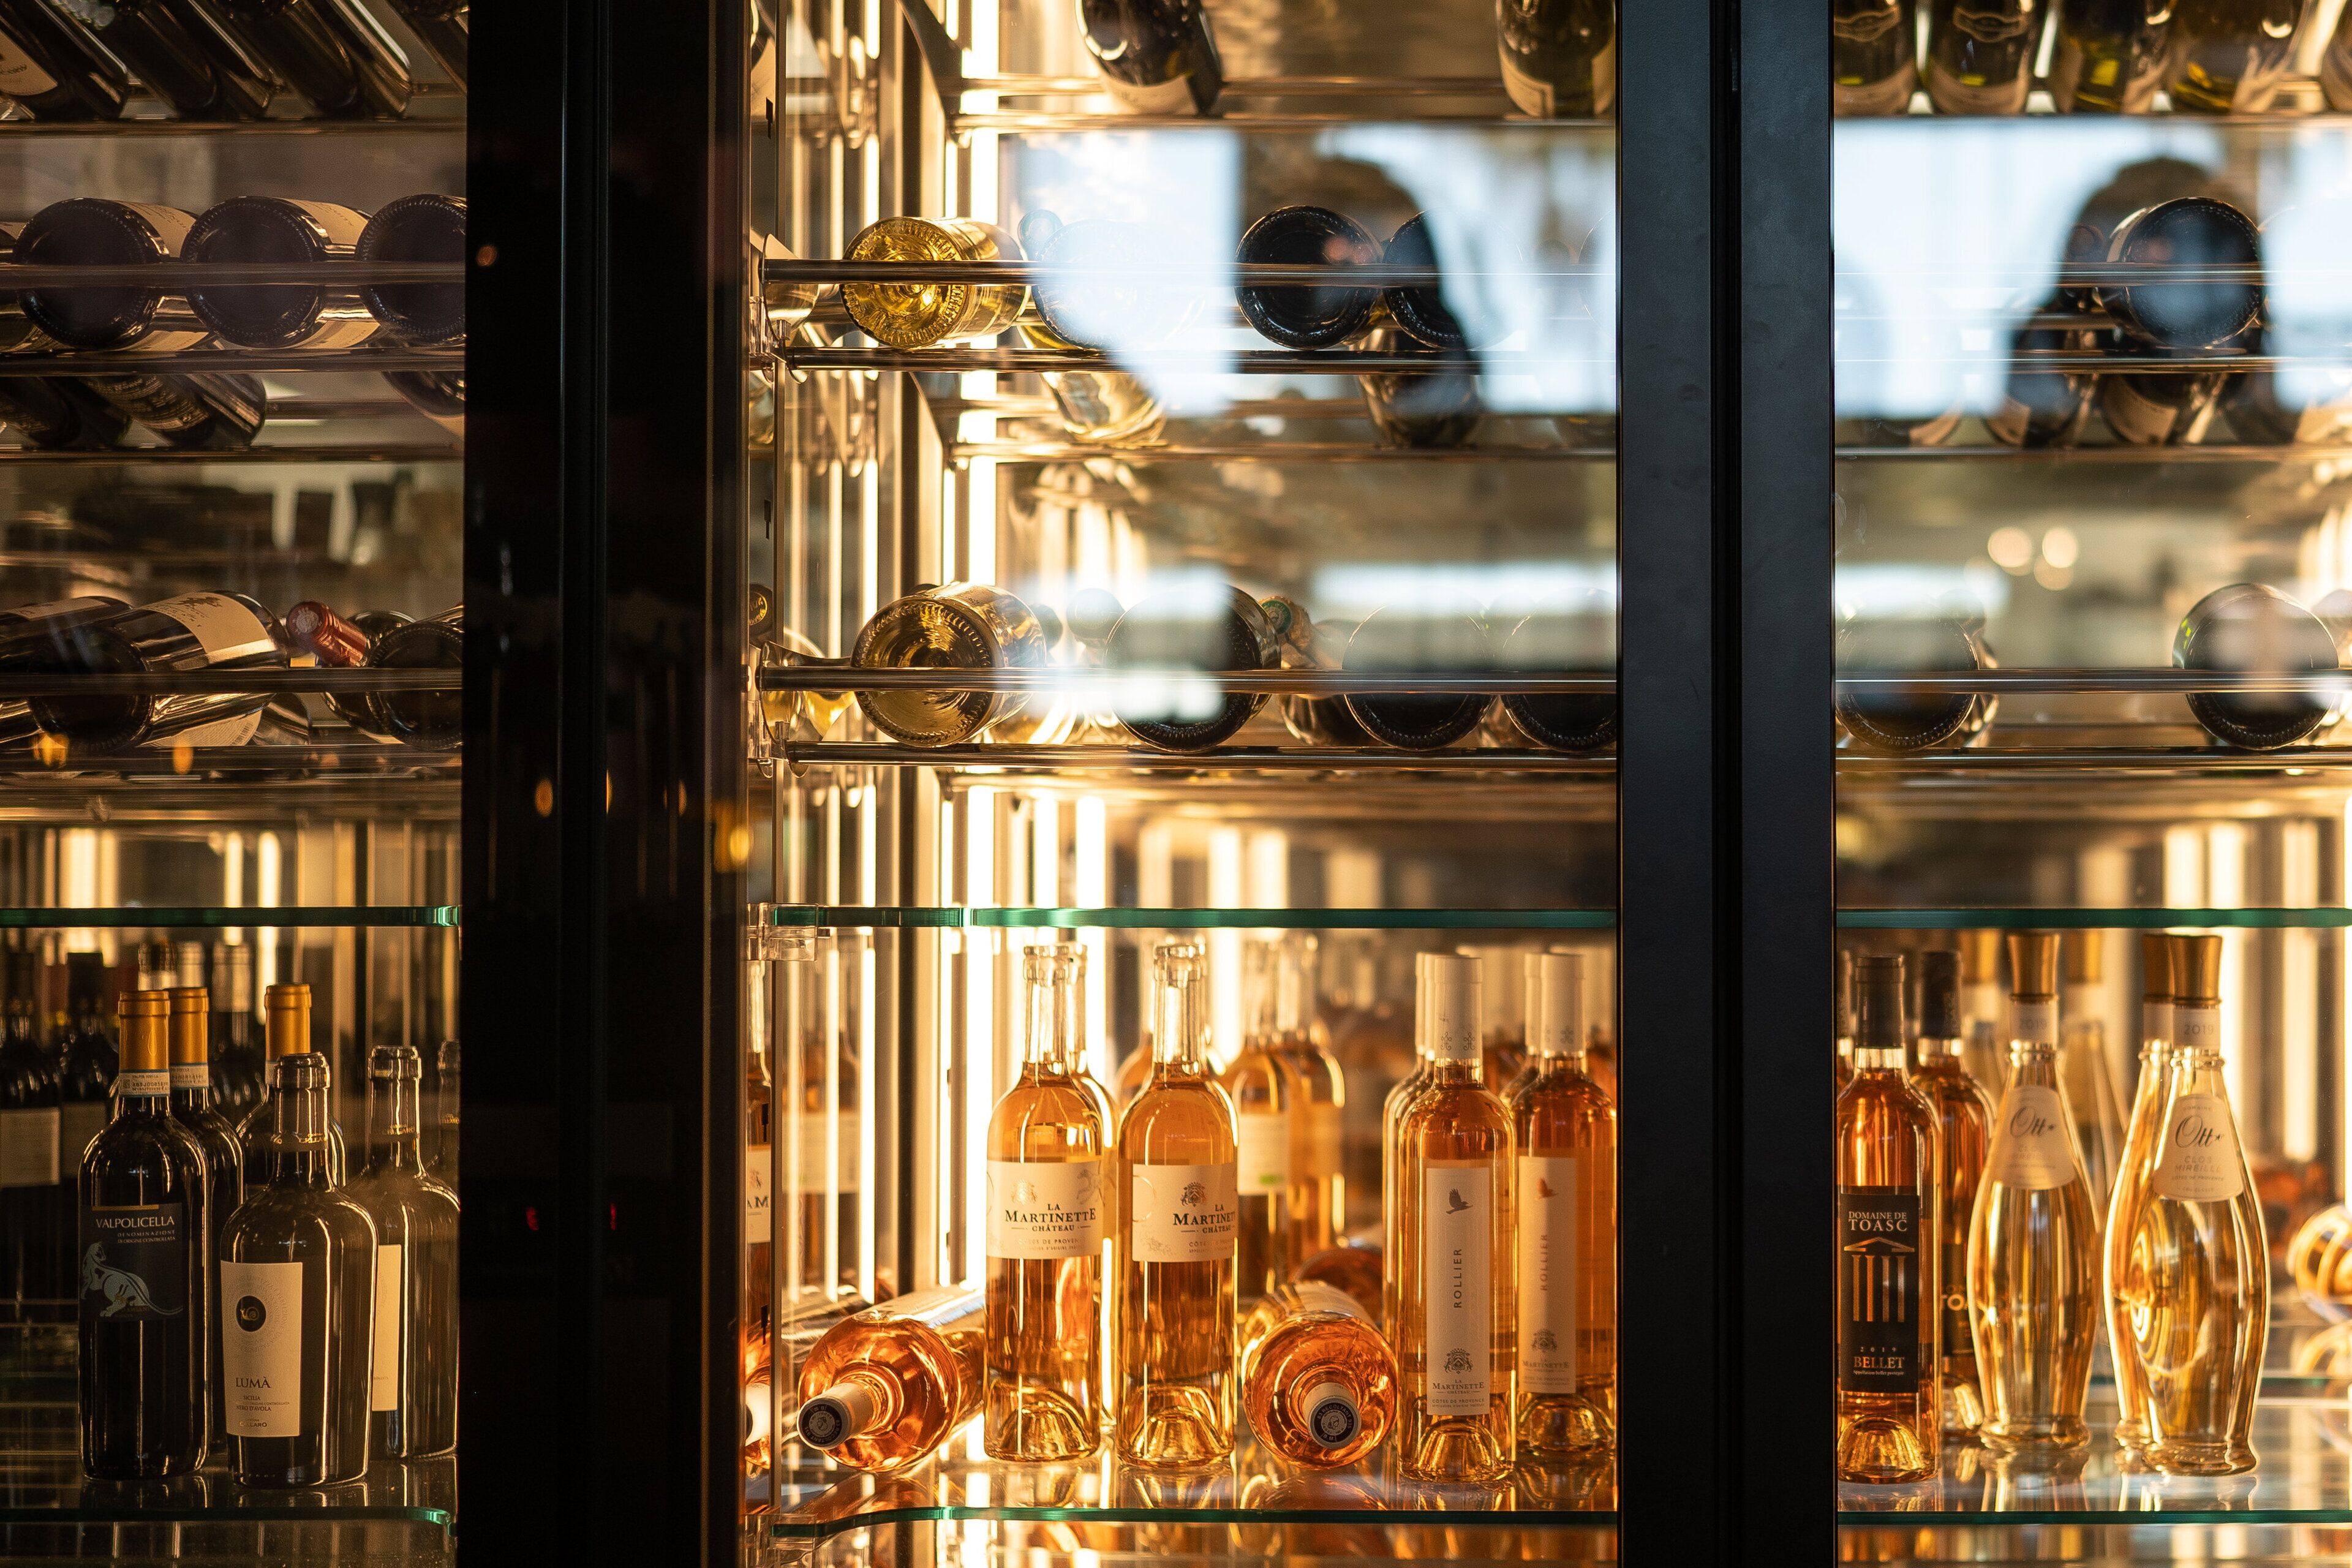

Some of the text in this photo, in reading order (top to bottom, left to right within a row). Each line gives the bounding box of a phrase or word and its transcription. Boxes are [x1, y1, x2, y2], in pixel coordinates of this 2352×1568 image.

[2184, 1023, 2214, 1035] 2019
[2010, 1106, 2046, 1137] Ott
[2176, 1115, 2214, 1148] Ott
[1215, 1204, 1224, 1212] LA
[1005, 1208, 1096, 1223] MARTINETTE
[1849, 1211, 1892, 1219] DOMAINE
[96, 1216, 175, 1229] VALPOLICELLA
[1849, 1219, 1907, 1232] TOASC
[1540, 1234, 1548, 1291] ROLLIER
[1453, 1249, 1462, 1308] ROLLIER
[1854, 1356, 1905, 1369] BELLET
[236, 1376, 271, 1389] LUMÀ
